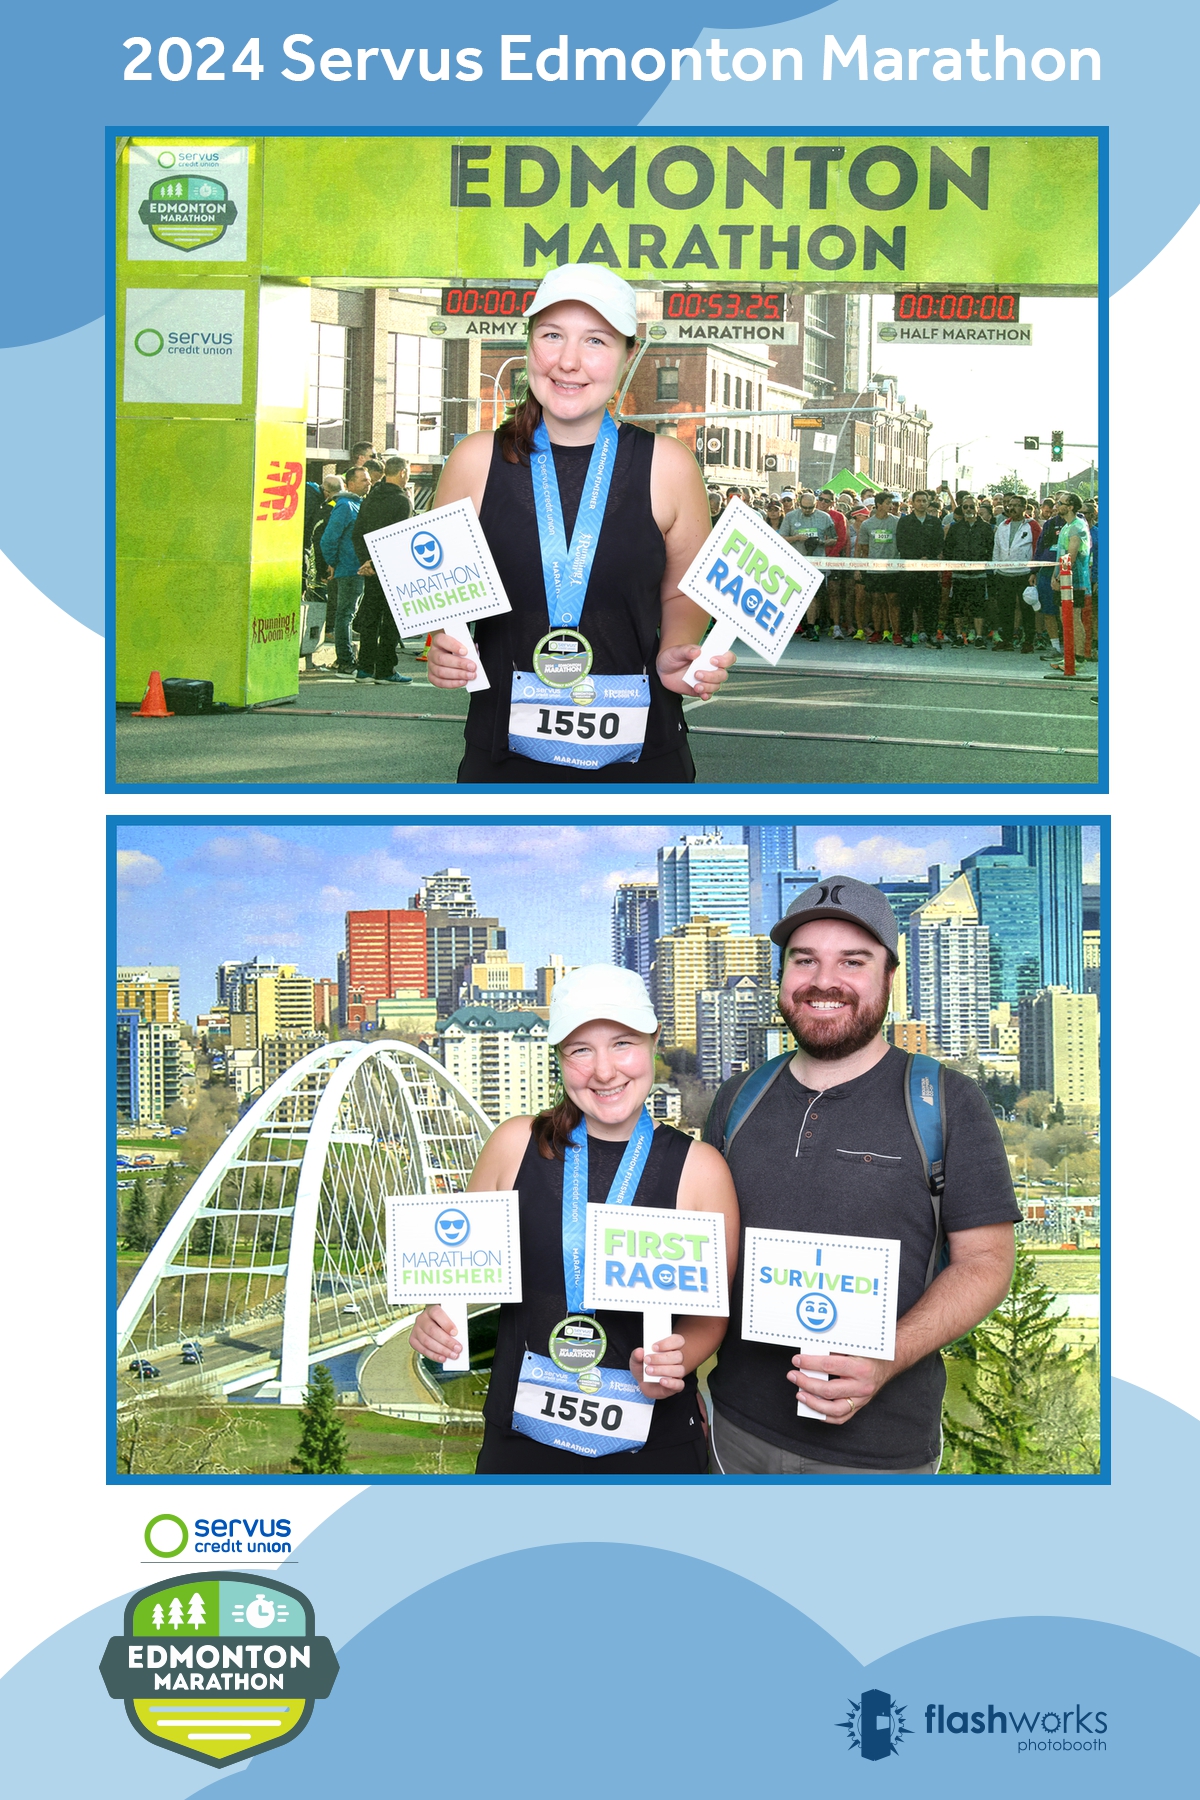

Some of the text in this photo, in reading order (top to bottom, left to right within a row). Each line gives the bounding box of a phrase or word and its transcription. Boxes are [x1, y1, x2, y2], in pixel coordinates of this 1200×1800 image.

[178, 152, 219, 161] servus
[449, 144, 990, 211] EDMONTON
[149, 203, 227, 214] EDMONTON
[160, 214, 215, 222] MARATHON
[522, 223, 906, 271] MARATHON
[168, 331, 233, 345] servus
[466, 321, 518, 335] ARMY
[679, 325, 785, 340] MARATHON
[901, 328, 1031, 341] HALF MARATHON
[168, 345, 233, 356] credit union
[589, 437, 610, 510] MARATHON FINISHER
[722, 528, 803, 607] FIRST
[396, 563, 481, 601] MARATHON
[401, 581, 488, 617] FINISHER!
[706, 557, 785, 636] RACE!
[537, 708, 621, 739] 1550
[554, 755, 599, 767] MARATHON
[616, 1135, 645, 1204] MARATHON FINISHER
[572, 1179, 580, 1201] credit
[604, 1228, 709, 1262] FIRST
[402, 1250, 502, 1268] MARATHON
[816, 1249, 822, 1266] I
[402, 1268, 502, 1285] FINISHER!
[606, 1260, 709, 1293] RACE!
[759, 1266, 879, 1296] SURVIVED!
[559, 1350, 596, 1359] MARATHON
[541, 1391, 623, 1431] 1550
[554, 1438, 597, 1455] MARATHON
